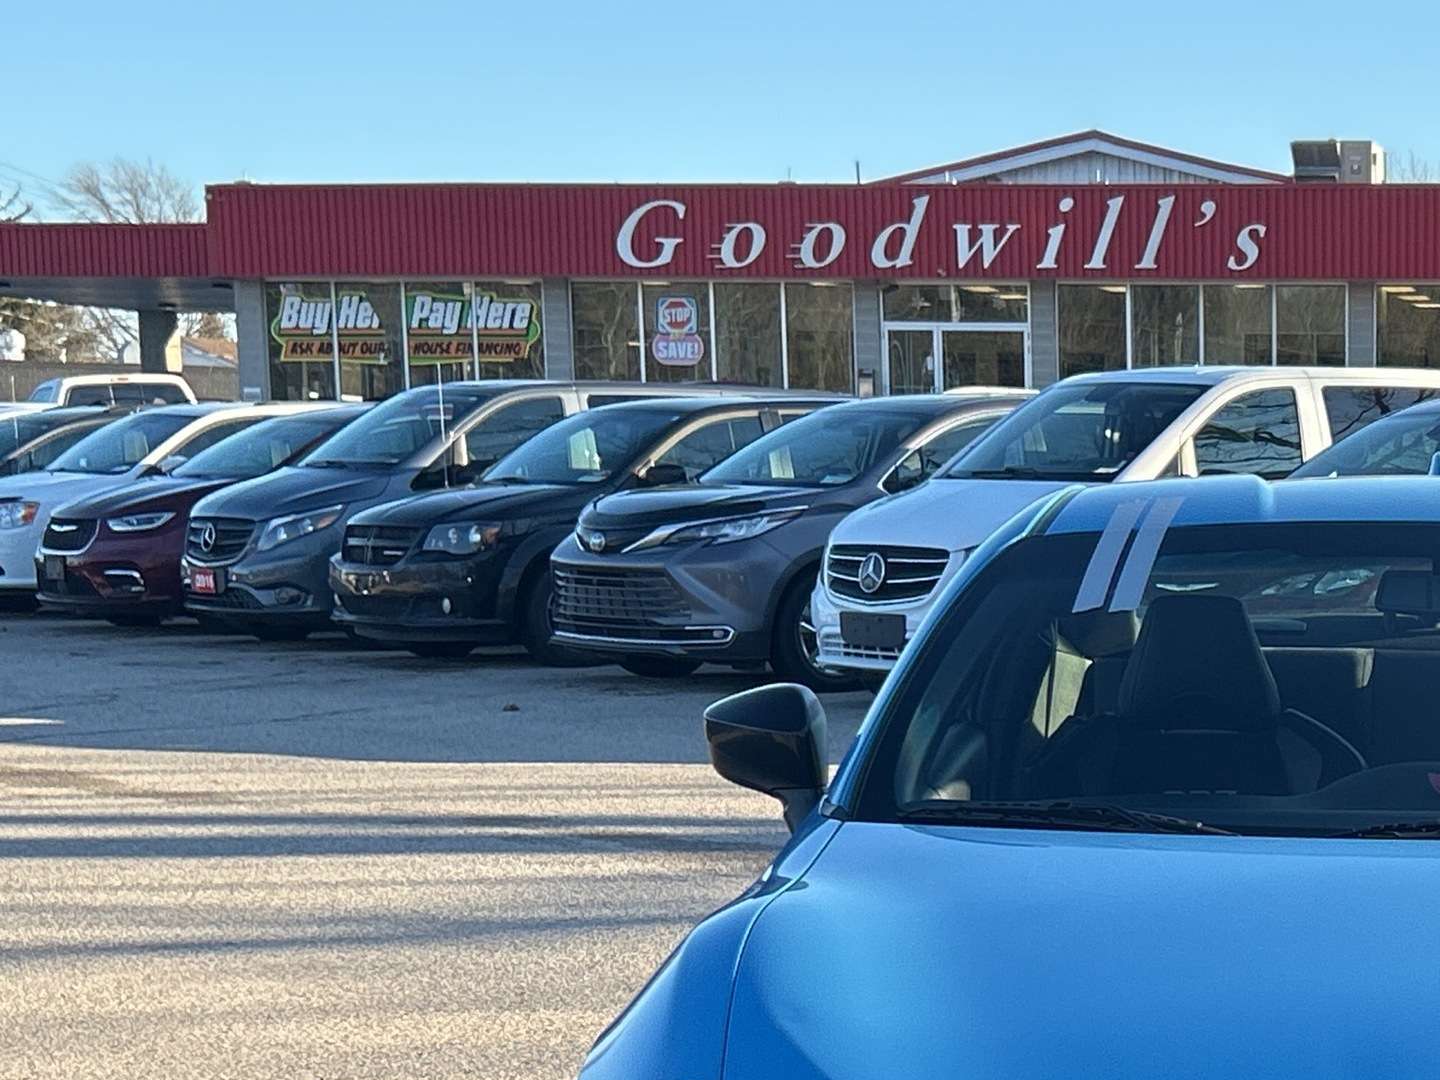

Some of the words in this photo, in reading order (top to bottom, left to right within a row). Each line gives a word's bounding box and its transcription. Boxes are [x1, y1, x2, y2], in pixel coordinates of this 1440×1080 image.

[616, 195, 1266, 270] Goodwill's
[281, 296, 331, 335] Buy
[411, 296, 462, 334] Pay
[467, 296, 531, 329] Here
[663, 308, 691, 323] STOP
[291, 341, 315, 356] ASK
[413, 341, 453, 356] HOUSE
[657, 341, 699, 359] SAVE!
